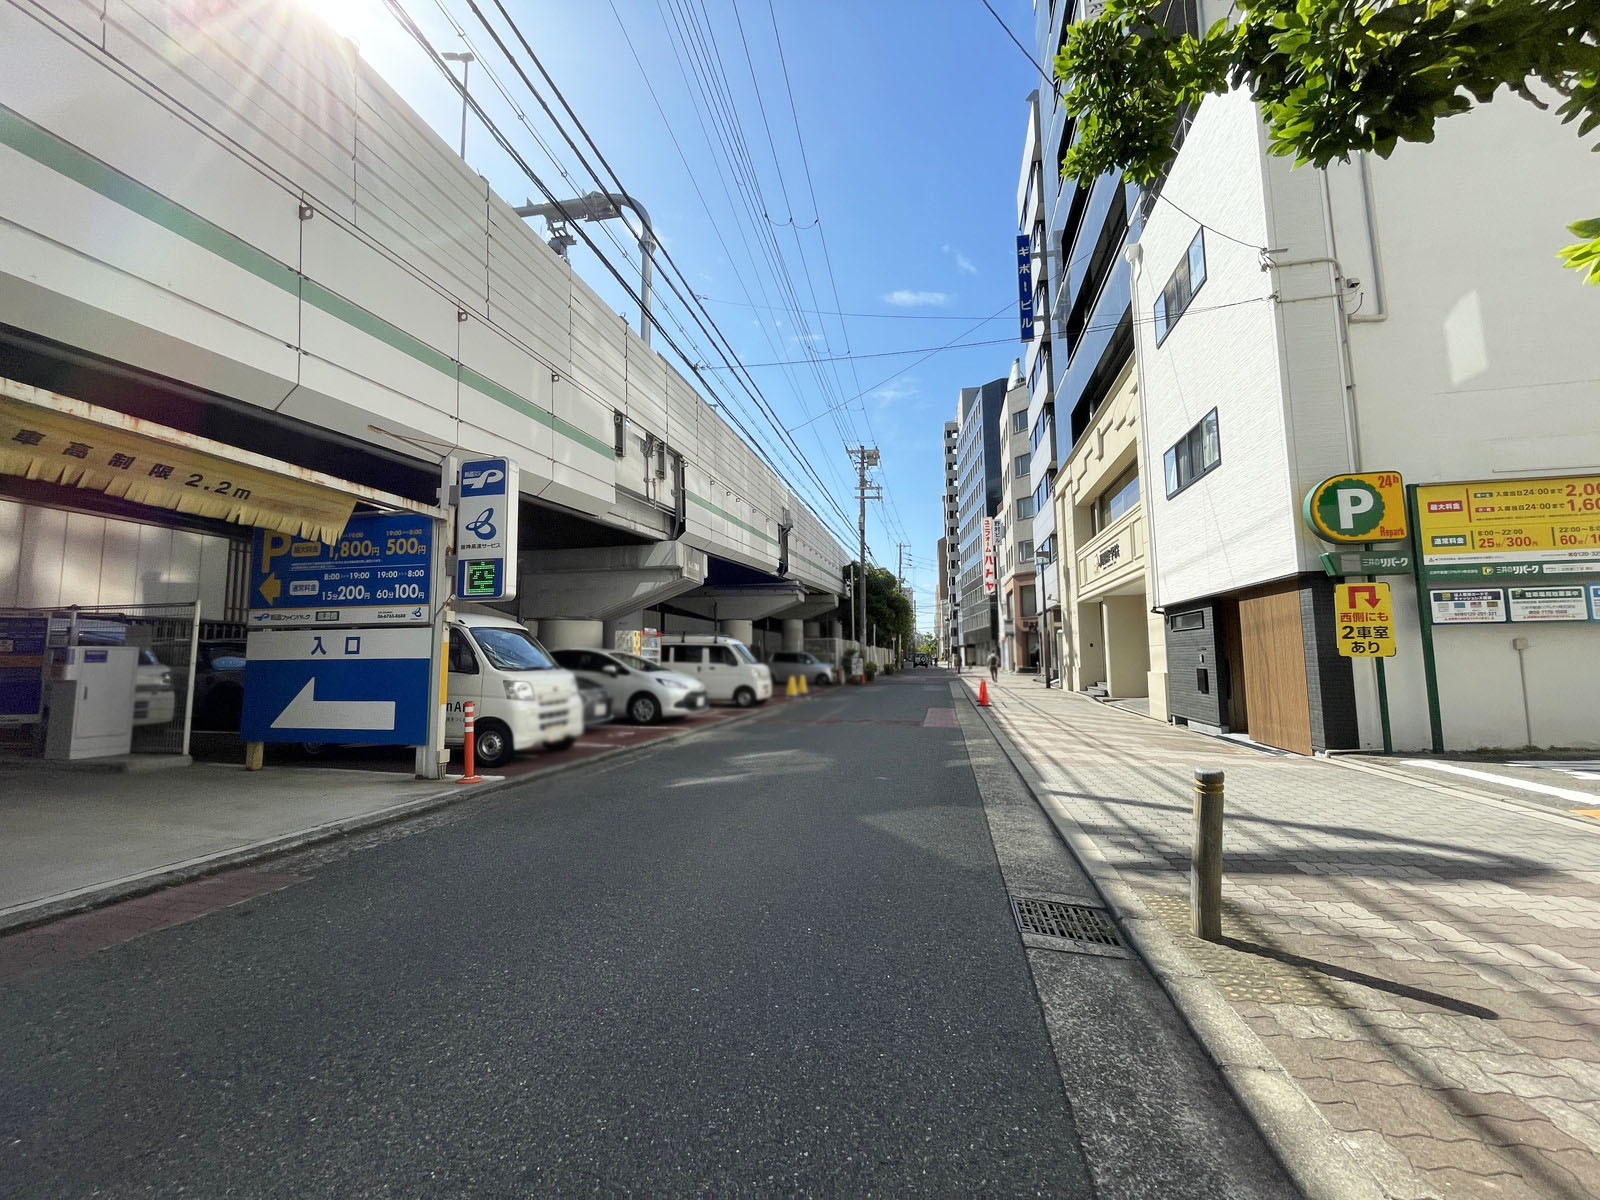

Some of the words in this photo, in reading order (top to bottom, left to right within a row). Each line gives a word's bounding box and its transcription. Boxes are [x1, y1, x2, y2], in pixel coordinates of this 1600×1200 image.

[1378, 475, 1399, 489] 24h
[1337, 488, 1374, 530] P
[1380, 526, 1405, 538] Repark
[386, 537, 426, 555] 500円
[1362, 556, 1409, 567] 三井のリパーク
[984, 555, 994, 591] ハトヤ
[1496, 565, 1539, 575] 三井のリパーク
[1340, 612, 1389, 623] 西側にも
[1341, 625, 1390, 640] 2車室
[311, 636, 361, 655] 入口
[1351, 641, 1380, 654] あり
